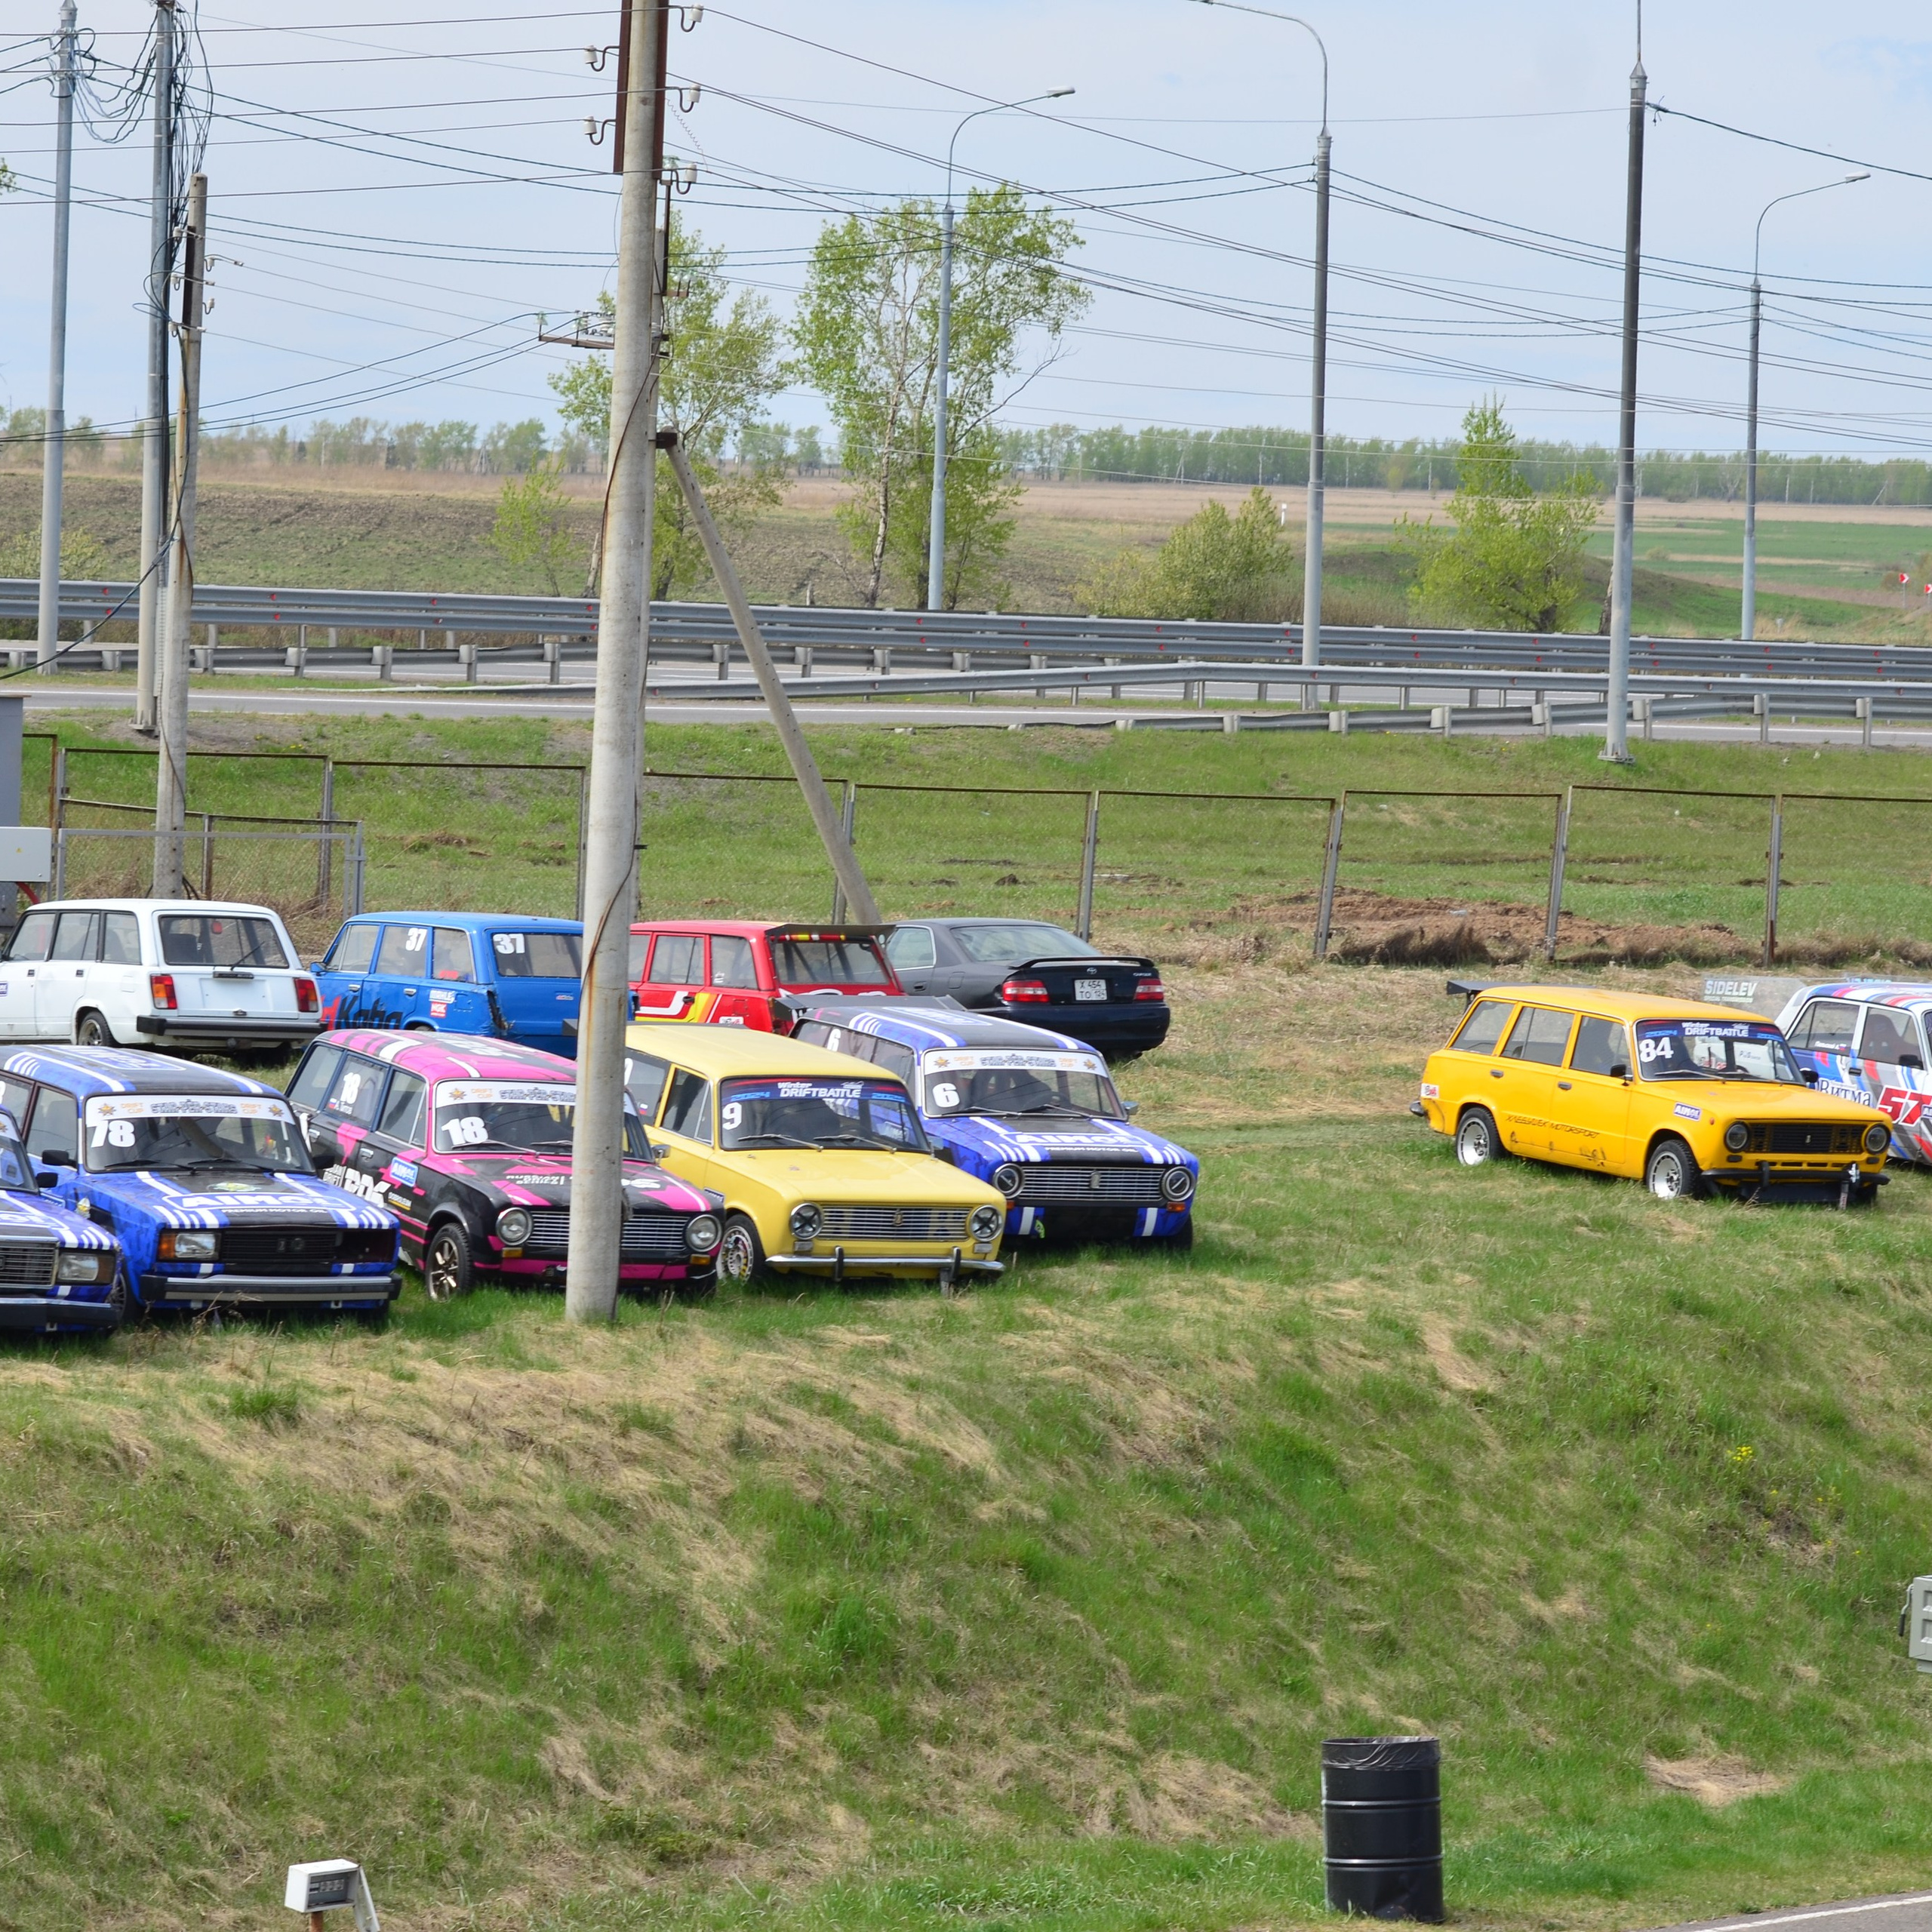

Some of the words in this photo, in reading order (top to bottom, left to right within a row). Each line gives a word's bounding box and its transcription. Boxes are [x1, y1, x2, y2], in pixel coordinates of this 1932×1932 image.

[405, 927, 427, 952] 37
[493, 933, 525, 955] 37
[1704, 980, 1758, 997] SIDELEV
[826, 1028, 841, 1052] 6
[1684, 1027, 1749, 1037] DRIFTBATTLE
[1639, 1037, 1674, 1063] 84
[341, 1072, 361, 1105] 18
[780, 1088, 862, 1098] DRIFTBATTLE
[932, 1082, 961, 1108] 6
[722, 1102, 743, 1131] 9
[1876, 1085, 1932, 1128] 57
[85, 1117, 136, 1148] 78
[441, 1116, 489, 1146] 18
[1015, 1134, 1144, 1146] AIMOL
[1549, 1121, 1600, 1139] MOTORSPORT
[182, 1195, 346, 1208] AIMOL
